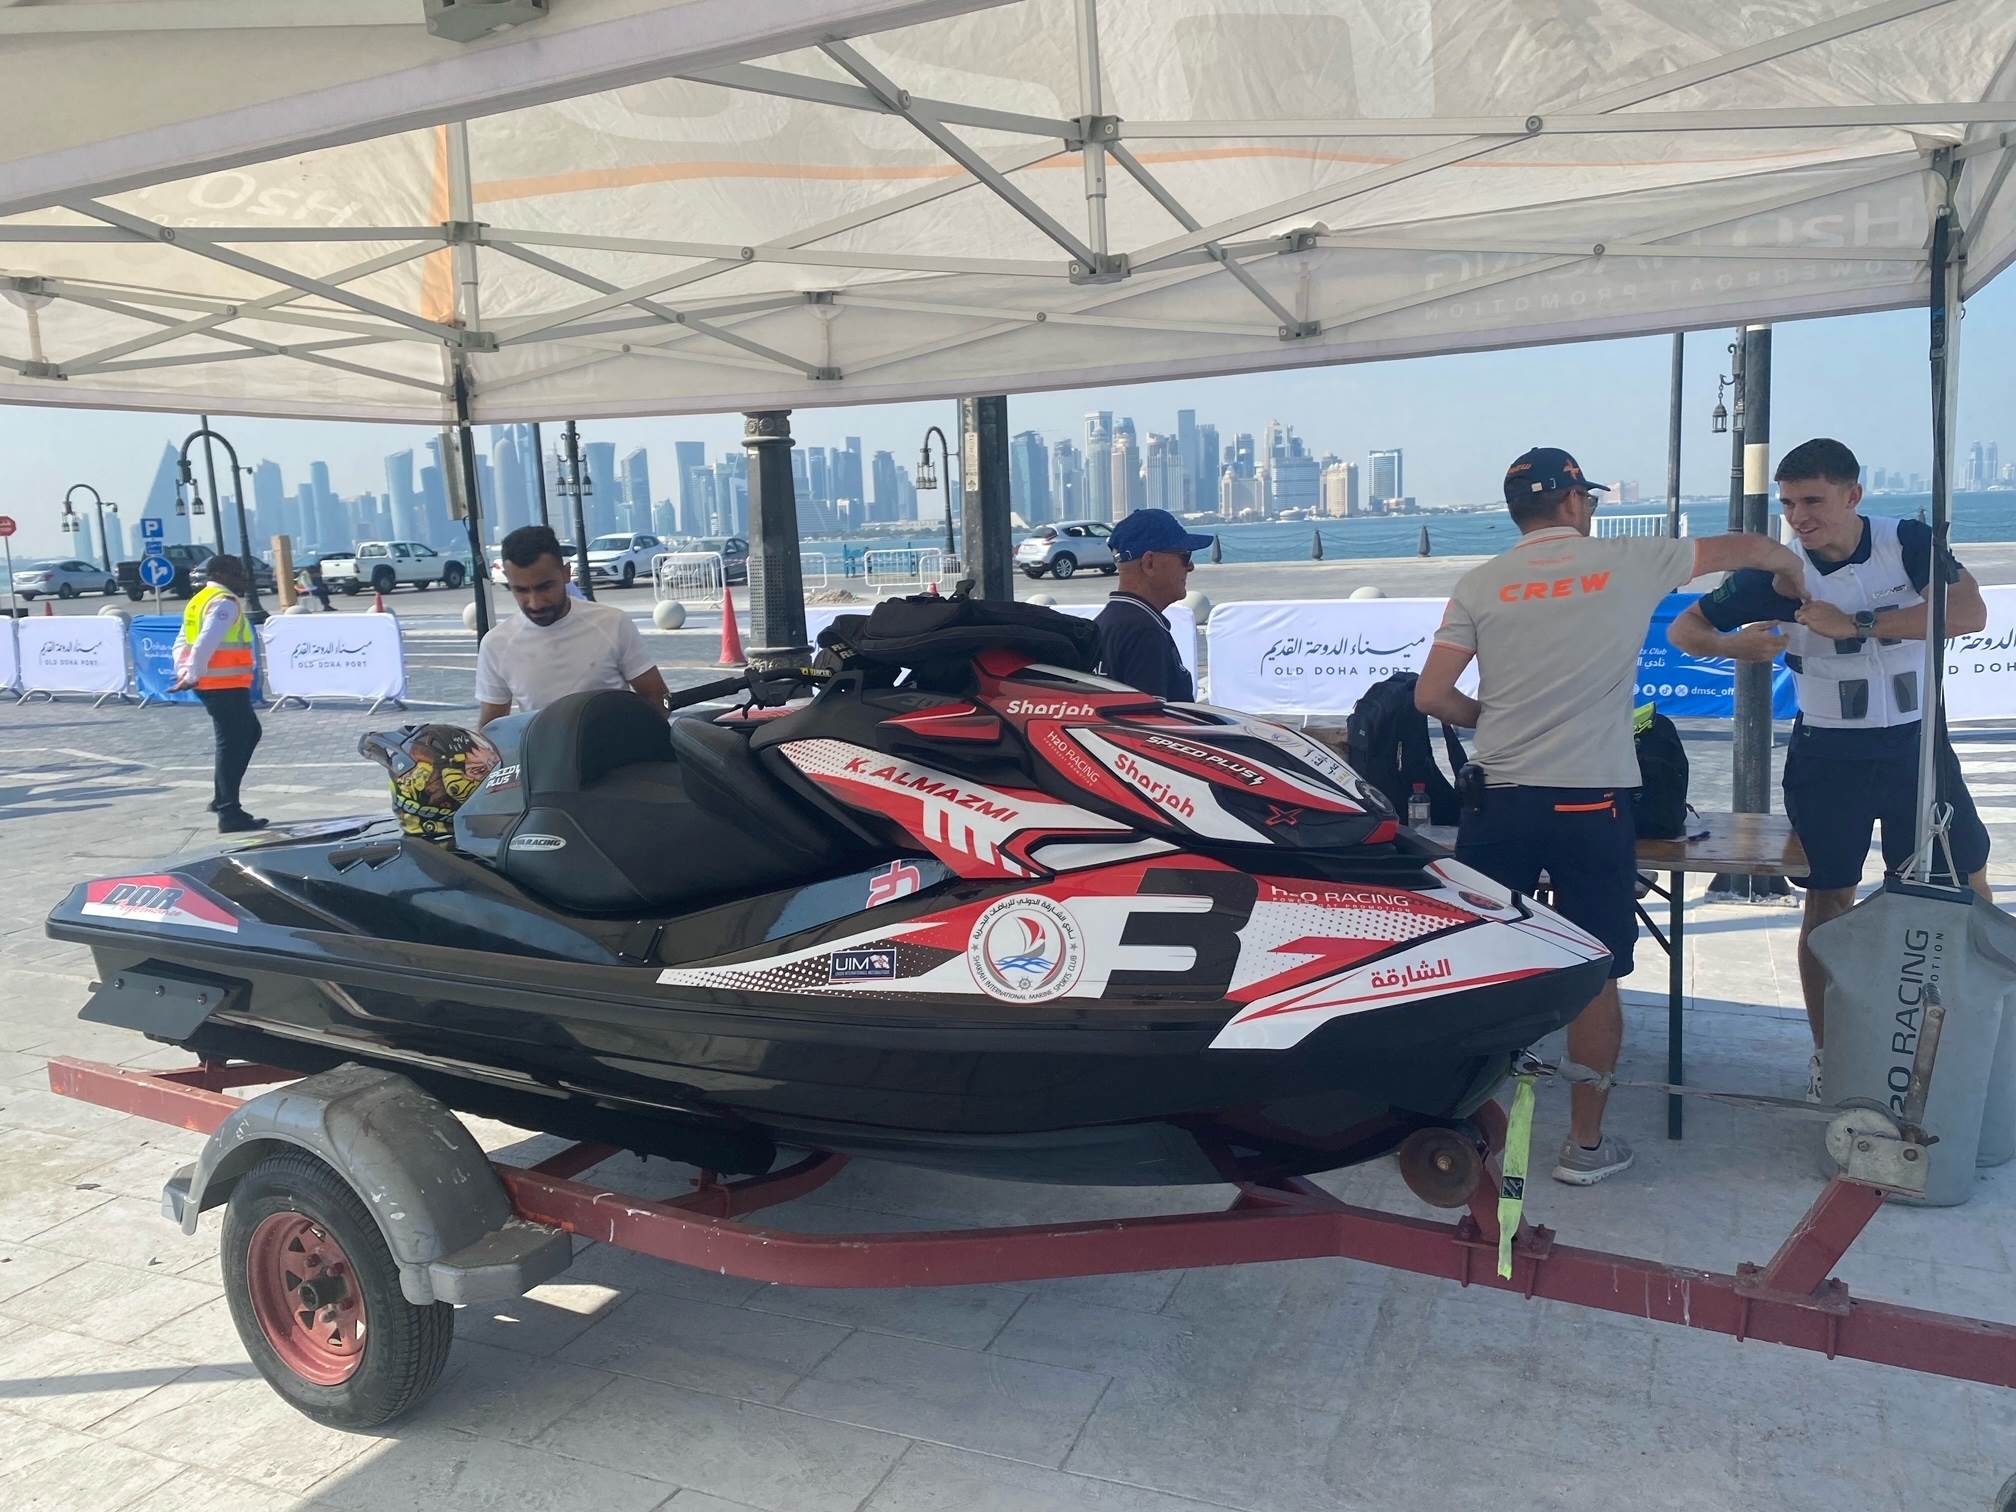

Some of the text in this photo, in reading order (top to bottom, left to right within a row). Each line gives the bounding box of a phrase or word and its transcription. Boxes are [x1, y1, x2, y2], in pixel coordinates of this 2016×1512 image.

[144, 520, 159, 536] P
[1499, 570, 1612, 602] CREW
[1260, 632, 1425, 677] ميناء الدوحة القديم
[1274, 667, 1304, 675] OLD
[1314, 666, 1358, 675] DOHA
[1974, 662, 2016, 673] DOH
[1690, 687, 1736, 698] dmsc_off
[1006, 700, 1095, 719] Sharjah
[1047, 731, 1101, 783] H2O RACING
[1145, 736, 1255, 778] SPEED PLUS
[843, 757, 1019, 823] K. ALMAZMI
[1115, 753, 1195, 818] Sharjah
[1325, 892, 1409, 907] RACING
[836, 956, 869, 970] UIM
[1371, 958, 1452, 988] الشارقة
[1931, 932, 1944, 983] OTION
[984, 980, 1028, 1000] INTERNATIONAL
[1028, 989, 1054, 1000] MARINE
[1053, 971, 1073, 992] SPORTS
[1067, 955, 1078, 971] CLUB
[1891, 928, 1929, 1055] RACING
